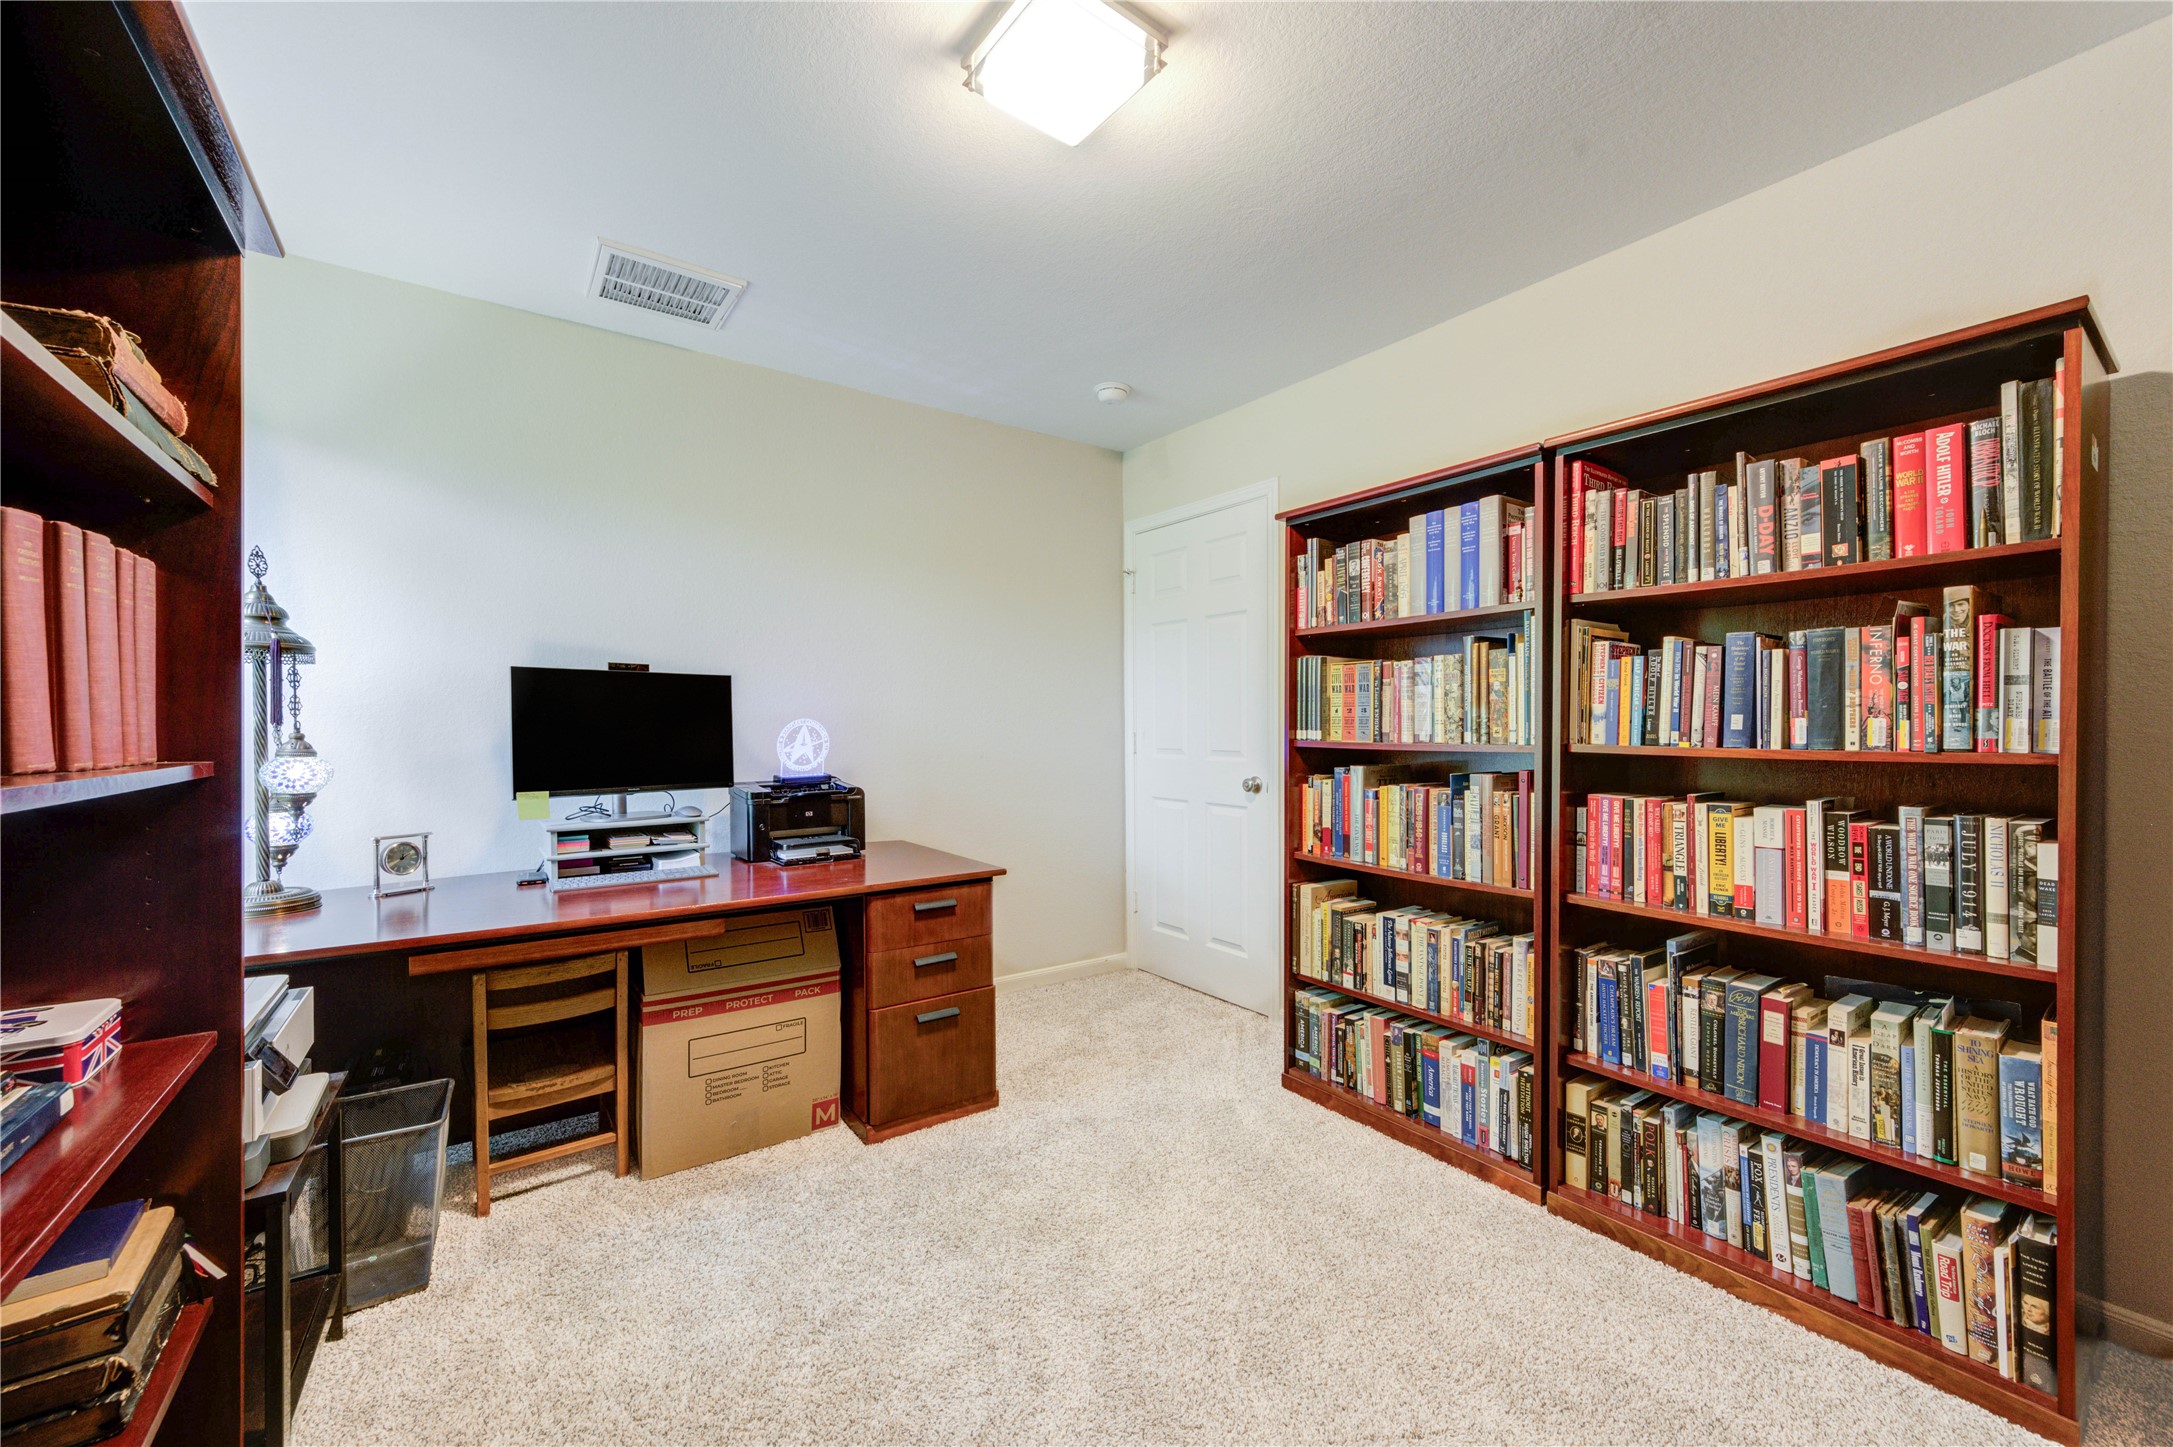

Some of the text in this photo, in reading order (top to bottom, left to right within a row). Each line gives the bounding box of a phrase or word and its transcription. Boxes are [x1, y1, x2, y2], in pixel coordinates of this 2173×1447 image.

[1971, 421, 2000, 432] MICHAEL
[1974, 428, 1996, 437] BLOCH
[1899, 448, 1920, 456] WORTH
[1936, 431, 1955, 497] ADOLF HITLER
[1896, 469, 1924, 480] WORLD
[1896, 477, 1916, 488] WAR
[1572, 491, 1580, 517] THIRD
[1784, 508, 1798, 539] ANZIO
[1936, 506, 1944, 535] TOLAND
[1945, 508, 1955, 528] JOHN
[1572, 520, 1580, 545] REICH
[1662, 514, 1671, 577] SPLENDID VILE
[1944, 628, 1967, 639] THE
[1944, 641, 1970, 652] WAR
[1869, 627, 1883, 685] INFERNO
[1982, 620, 1995, 698] DOCTORS FROM HELL
[2043, 658, 2052, 667] THE
[2042, 669, 2053, 690] BATTLE
[1598, 678, 1606, 705] CITIZEN
[1711, 685, 1719, 703] MEIN
[2007, 698, 2015, 718] DIARY
[2043, 700, 2052, 708] THE
[1674, 826, 1685, 872] TRIANGLE
[1715, 831, 1727, 866] LIBERTY!
[1827, 825, 1835, 859] WILSON
[1837, 820, 1846, 866] WOODROW
[1885, 840, 1893, 862] WORLD
[1739, 829, 1748, 882] GUNS AUGUST
[1810, 842, 1818, 865] WORLD
[1990, 825, 2005, 888] NICHOLAS II
[1885, 862, 1894, 890] UNDONE
[1906, 818, 1919, 928] THE WORLD WAR ONE SOURCE BOOK
[1961, 830, 1977, 918] JULY 1914
[2039, 880, 2057, 888] DEAD
[794, 985, 822, 998] PACK
[725, 994, 775, 1011] PROTECT
[672, 1006, 703, 1019] PREP
[782, 1020, 804, 1030] FRAGILE
[1872, 1029, 1898, 1040] LEAP
[1968, 1038, 1982, 1047] TO
[1690, 1038, 1698, 1059] GIANT
[1736, 1020, 1747, 1085] RICHARD NIXON
[1872, 1040, 1899, 1052] DARK
[1957, 1045, 1995, 1059] SHINING
[768, 1062, 790, 1071] KITCHEN
[1967, 1054, 1985, 1065] SEA
[712, 1071, 748, 1083] DINING ROOM
[712, 1075, 760, 1090] MASTER BEDROOM
[768, 1074, 789, 1083] GARAGE
[1428, 1065, 1436, 1098] America
[1957, 1067, 1995, 1080] HISTORY
[712, 1086, 740, 1096] BEDROOM
[768, 1080, 791, 1090] STORAGE
[2028, 1081, 2036, 1098] WHAT
[712, 1092, 742, 1103] BATHROOM
[1479, 1088, 1488, 1124] Stories
[2014, 1080, 2027, 1126] WROUGHT
[815, 1103, 836, 1126] M
[2029, 1115, 2037, 1129] GOD
[1645, 1122, 1656, 1157] POLK
[1723, 1129, 1732, 1164] CRISIS
[1753, 1161, 1764, 1184] POX
[2006, 1164, 2037, 1178] HOWE
[1768, 1156, 1781, 1212] PRESIDENTS
[1968, 1224, 1988, 1233] JOHN
[2031, 1256, 2049, 1266] THREE
[1938, 1256, 1954, 1299] Road Trip
[2022, 1276, 2047, 1288] MADISON
[2025, 1270, 2044, 1279] JAMES
